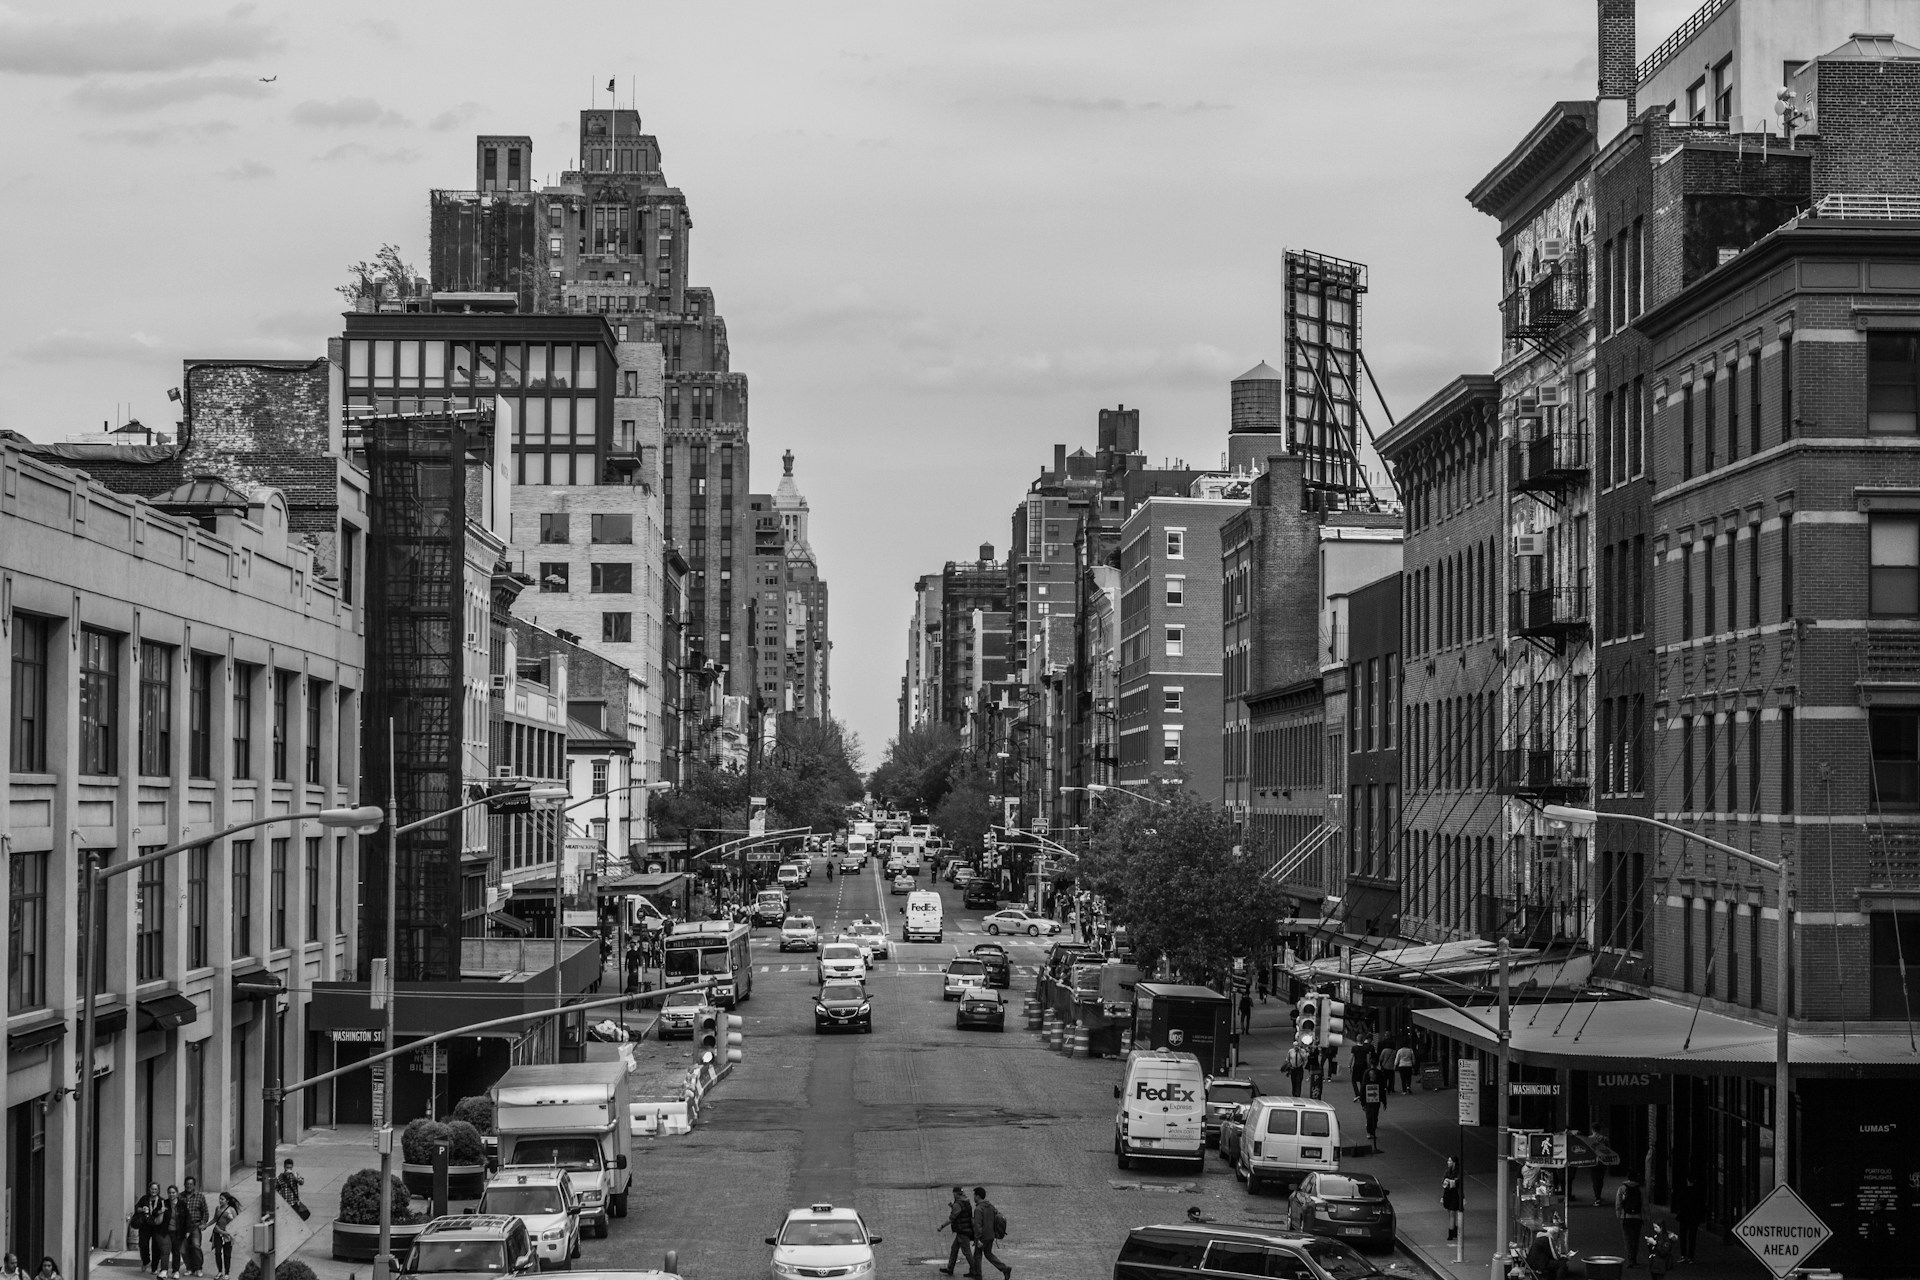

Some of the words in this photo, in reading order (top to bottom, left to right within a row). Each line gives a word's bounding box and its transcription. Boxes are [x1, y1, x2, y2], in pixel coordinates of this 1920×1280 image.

[911, 903, 937, 912] FedEx
[333, 1031, 372, 1042] WASHINGTON
[373, 1031, 382, 1042] ST
[1170, 1034, 1183, 1044] ups
[1598, 1074, 1651, 1087] LUMAS
[1136, 1082, 1195, 1102] FedEx
[1513, 1085, 1551, 1095] WASHINGTON
[1552, 1085, 1561, 1095] ST
[1170, 1103, 1193, 1111] Express
[1860, 1124, 1891, 1133] LUMAS
[1742, 1225, 1821, 1238] CONSTRUCTION
[1763, 1244, 1800, 1256] AHEAD
